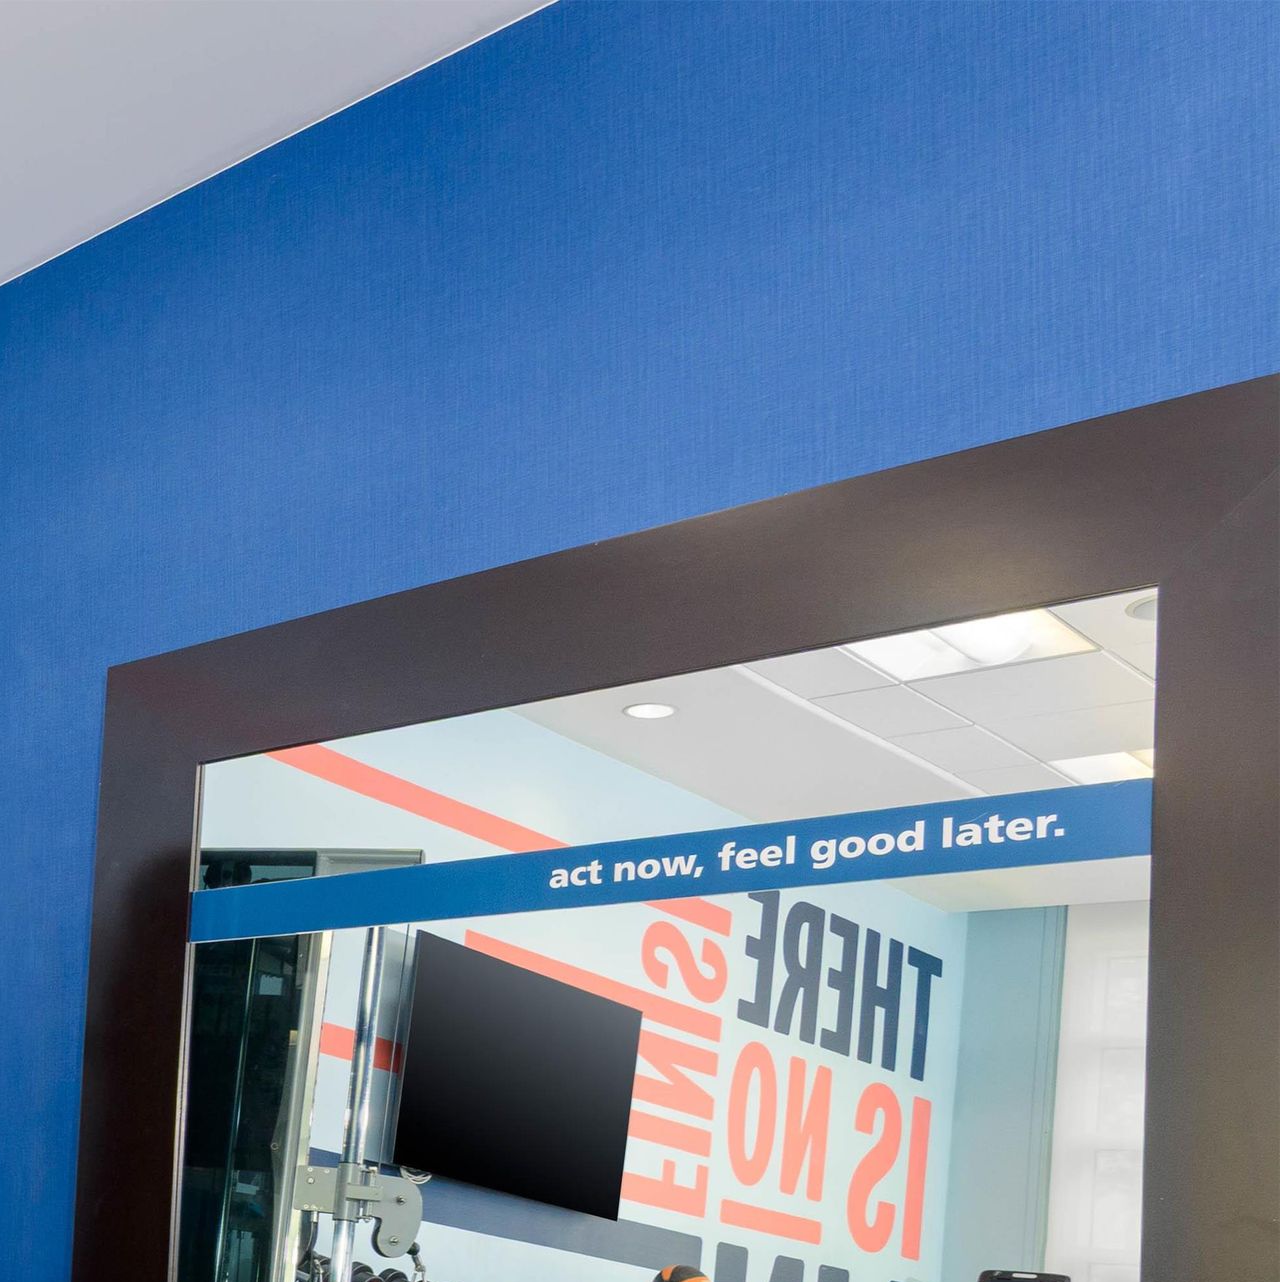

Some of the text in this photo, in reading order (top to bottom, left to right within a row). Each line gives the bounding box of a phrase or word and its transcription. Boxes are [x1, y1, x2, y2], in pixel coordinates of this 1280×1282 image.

[549, 811, 1066, 889] act now, feel good later.
